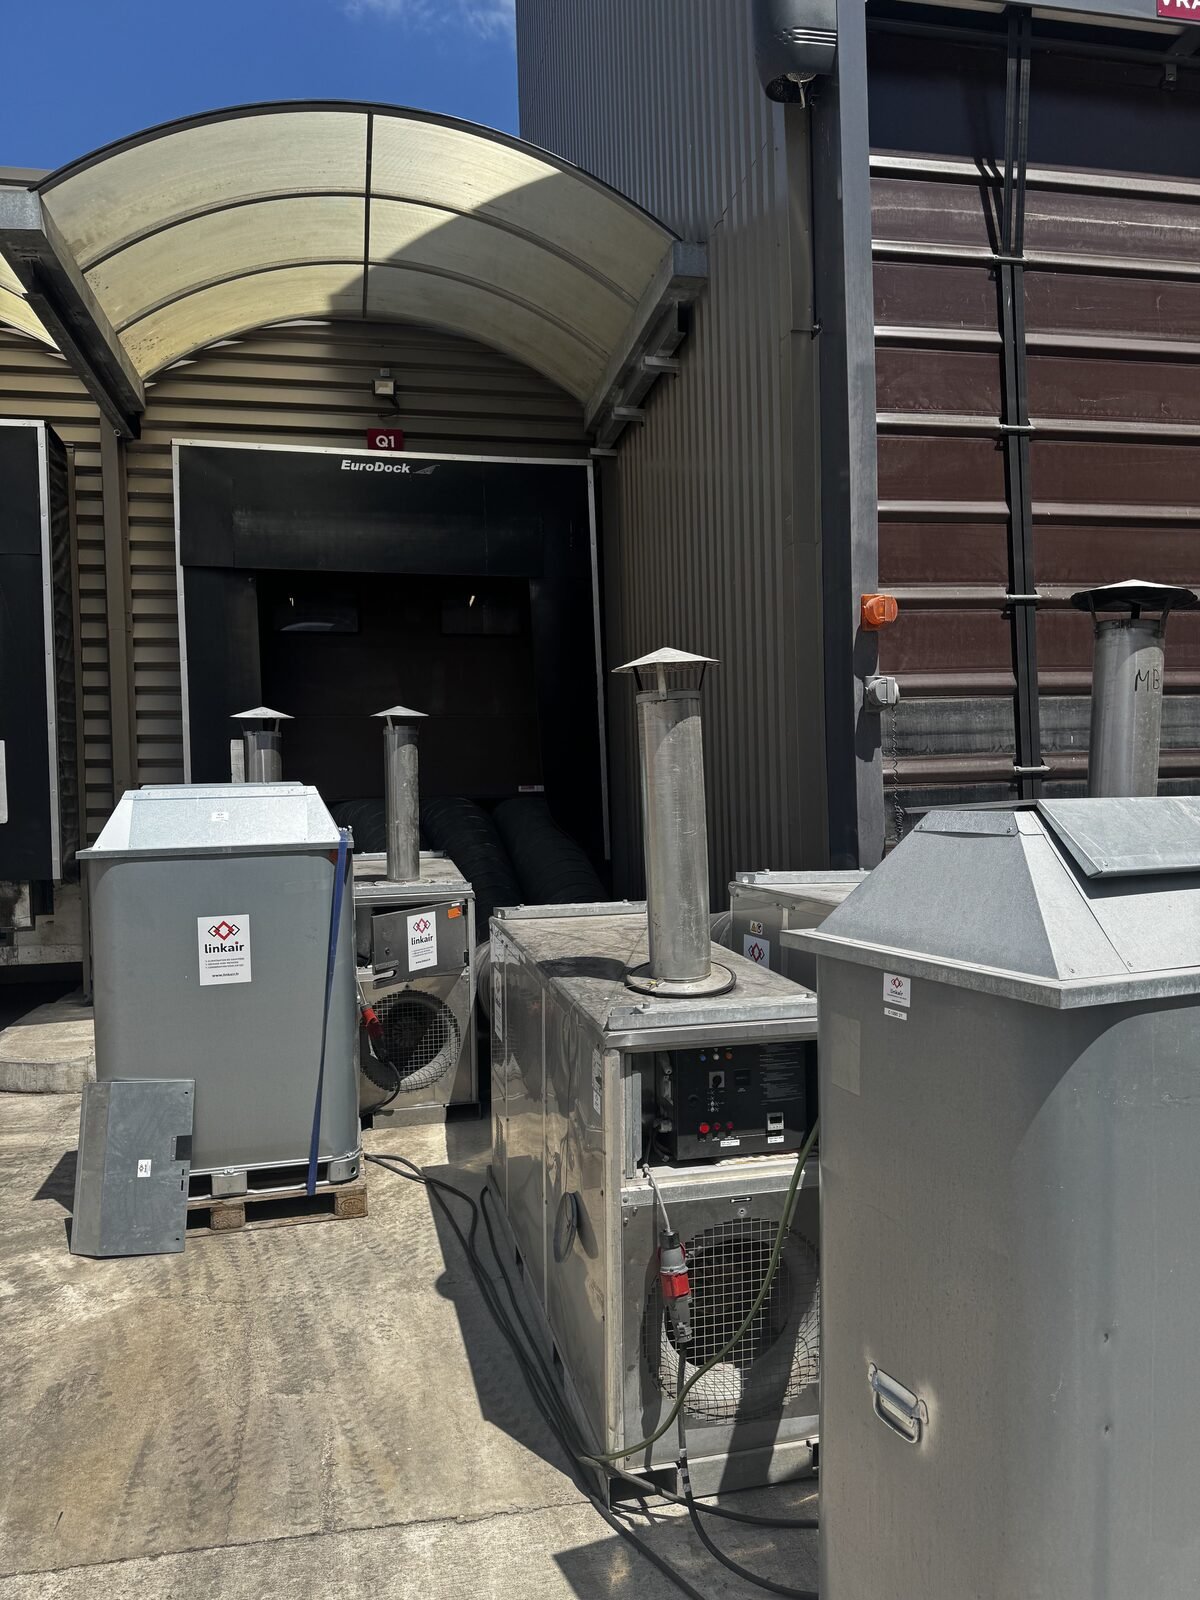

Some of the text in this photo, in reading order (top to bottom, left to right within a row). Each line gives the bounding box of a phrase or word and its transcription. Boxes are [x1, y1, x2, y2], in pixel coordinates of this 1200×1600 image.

[375, 435, 395, 448] Q1
[341, 459, 411, 474] EuroDock
[1134, 668, 1160, 692] MB
[204, 941, 245, 954] linkair
